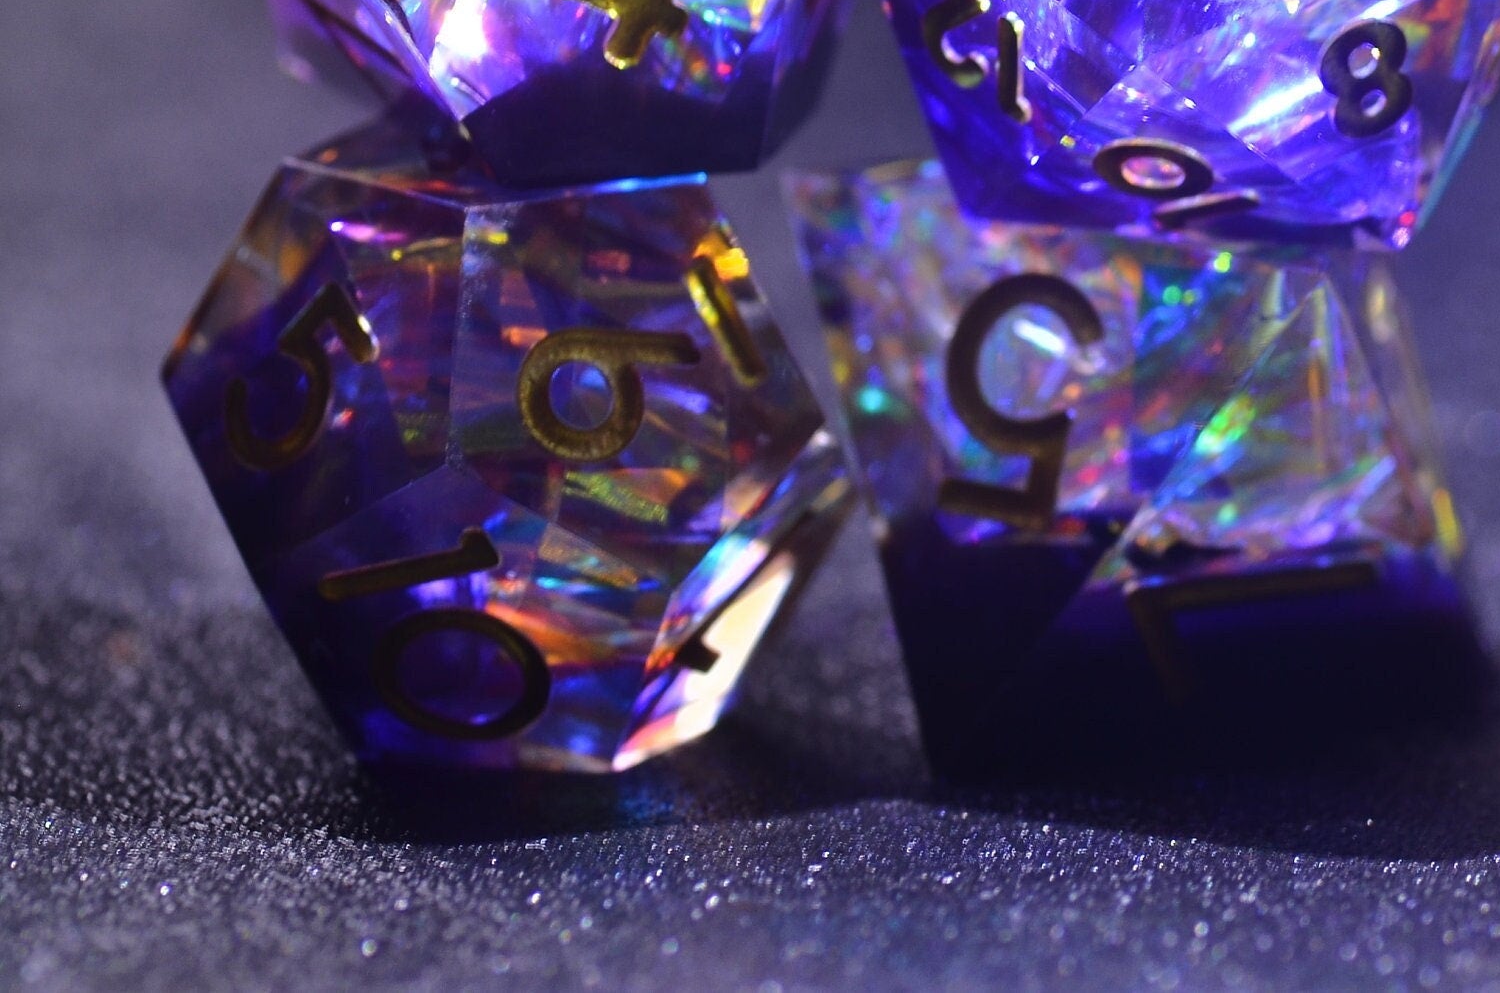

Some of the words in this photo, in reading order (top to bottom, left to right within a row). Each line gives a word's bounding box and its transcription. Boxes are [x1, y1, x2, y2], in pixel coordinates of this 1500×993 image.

[1320, 18, 1413, 139] 8
[938, 273, 1105, 533] 5
[317, 526, 553, 742] 10
